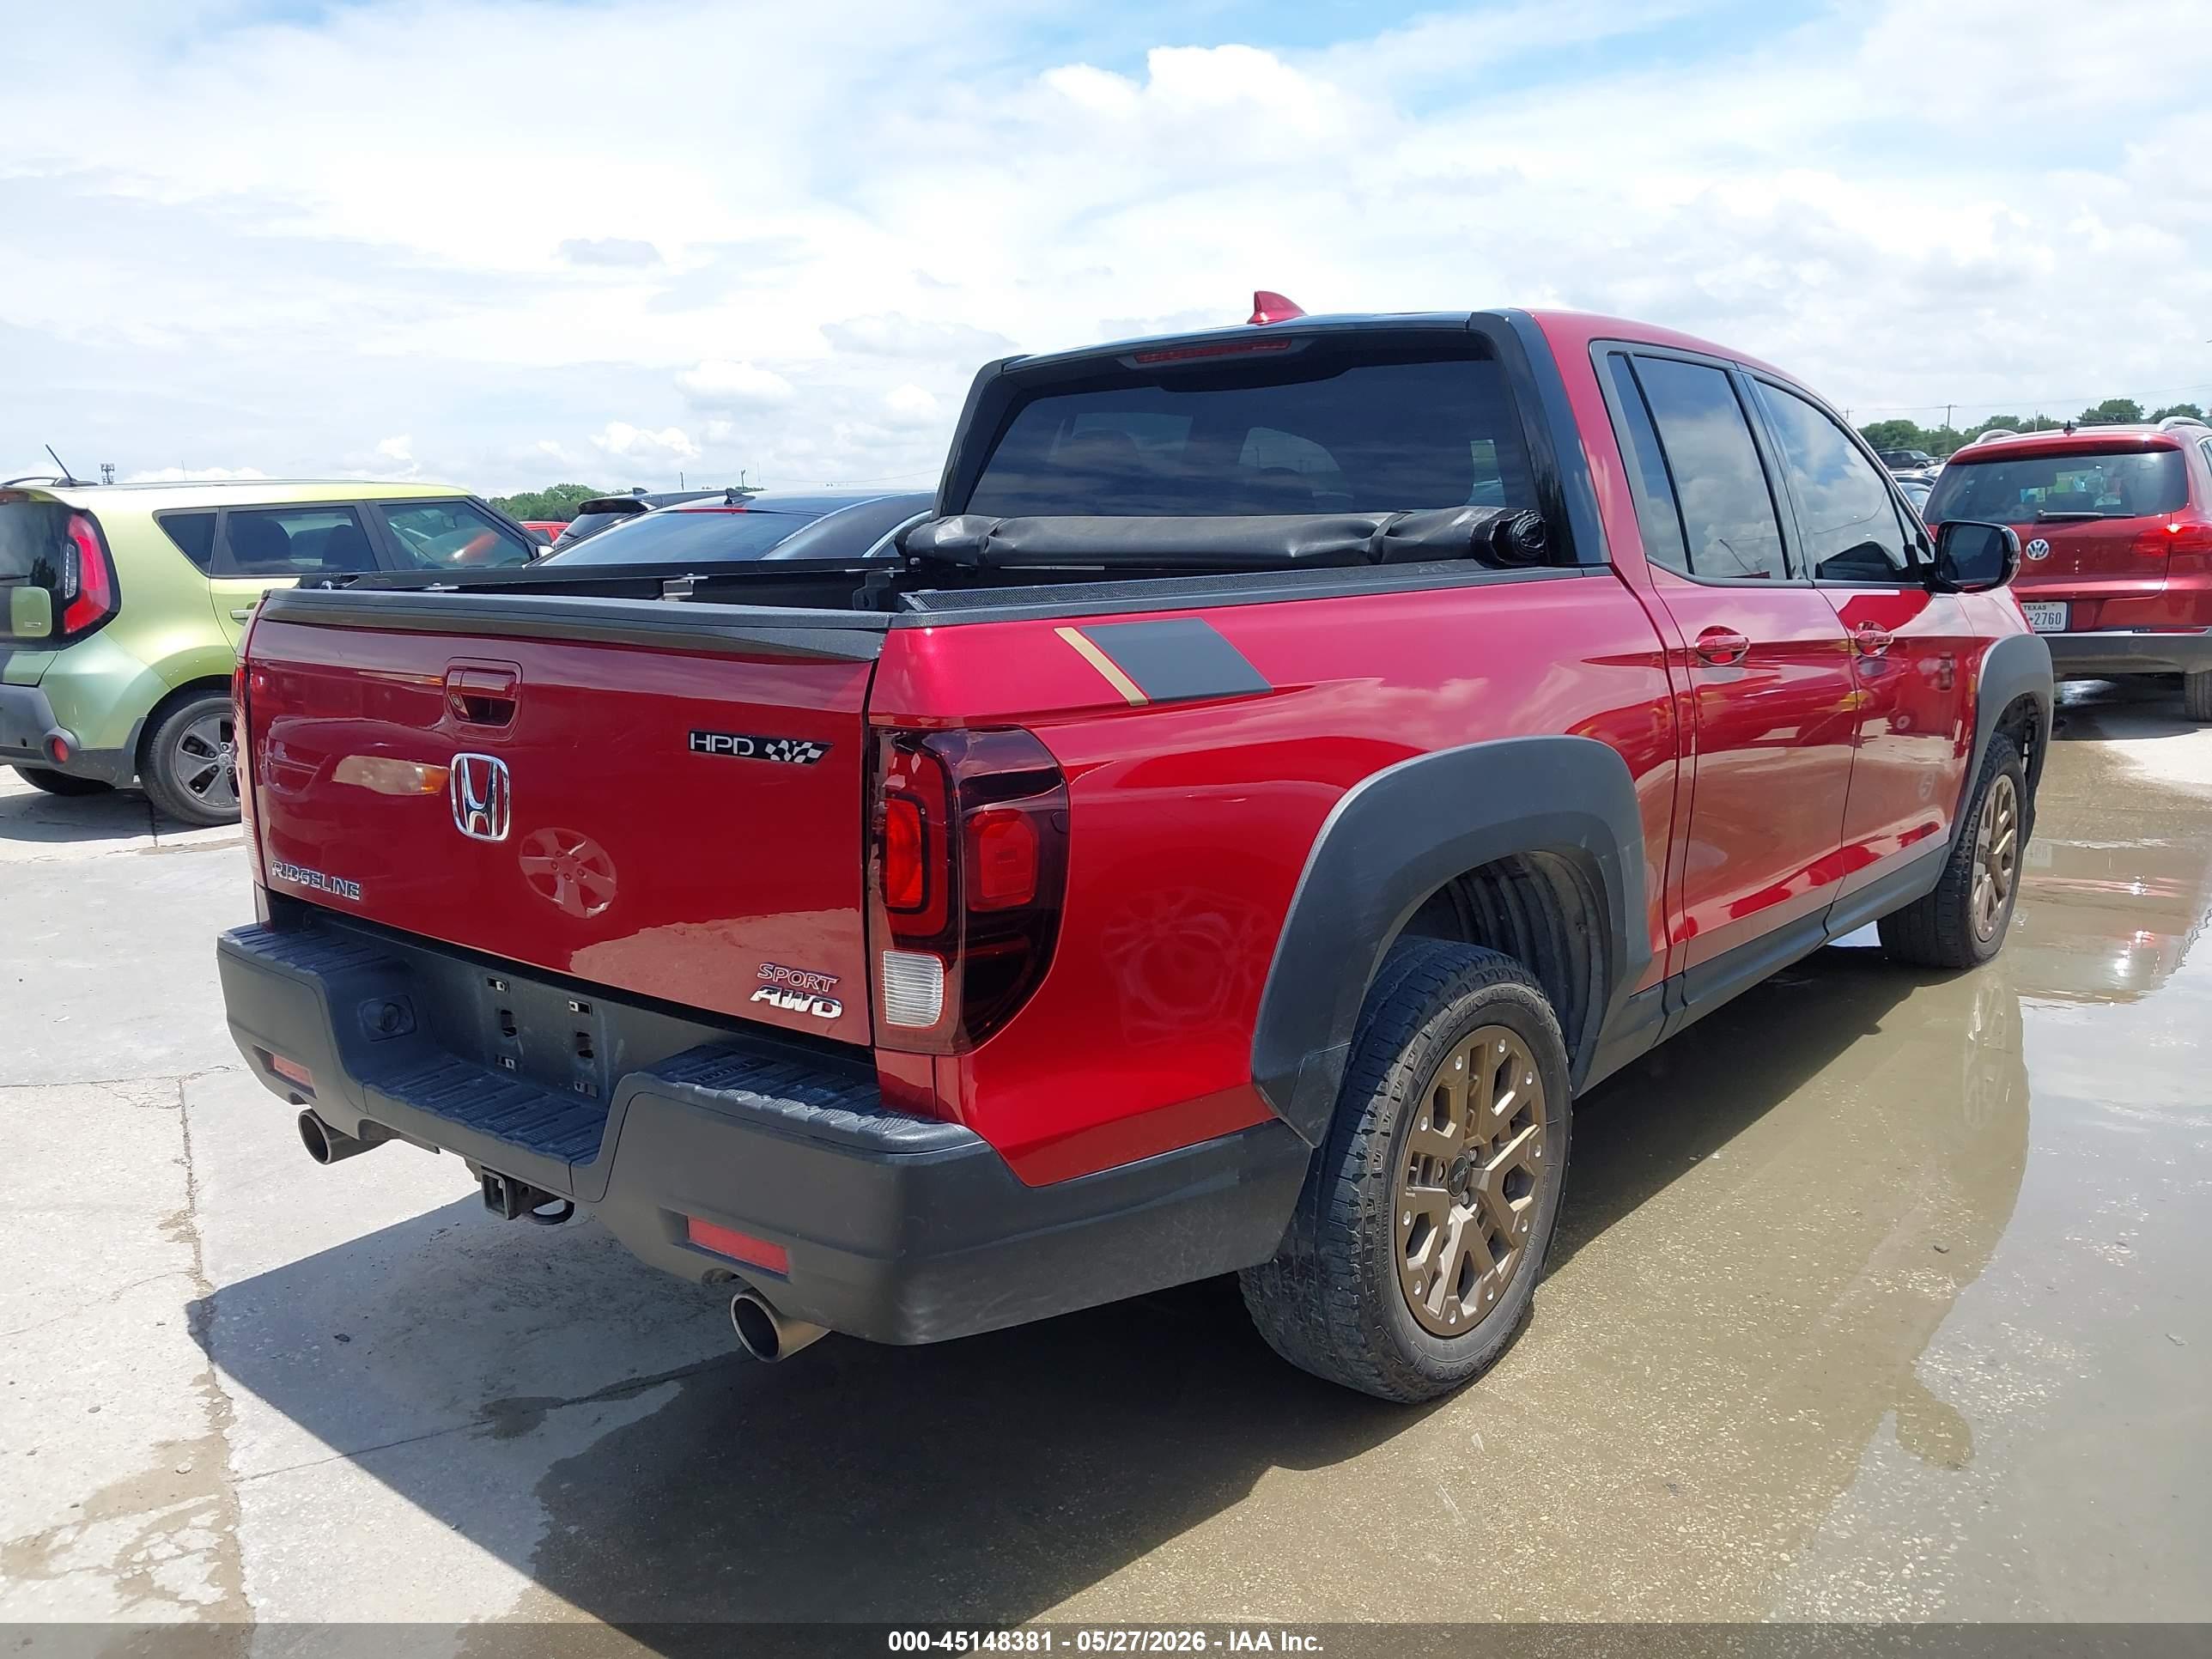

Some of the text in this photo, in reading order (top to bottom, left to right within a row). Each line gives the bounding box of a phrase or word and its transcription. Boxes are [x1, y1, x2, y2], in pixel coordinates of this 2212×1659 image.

[690, 732, 755, 756] HPD
[271, 860, 361, 901] RIDGELINE
[757, 963, 839, 993] SPORT
[750, 984, 842, 1018] AWD
